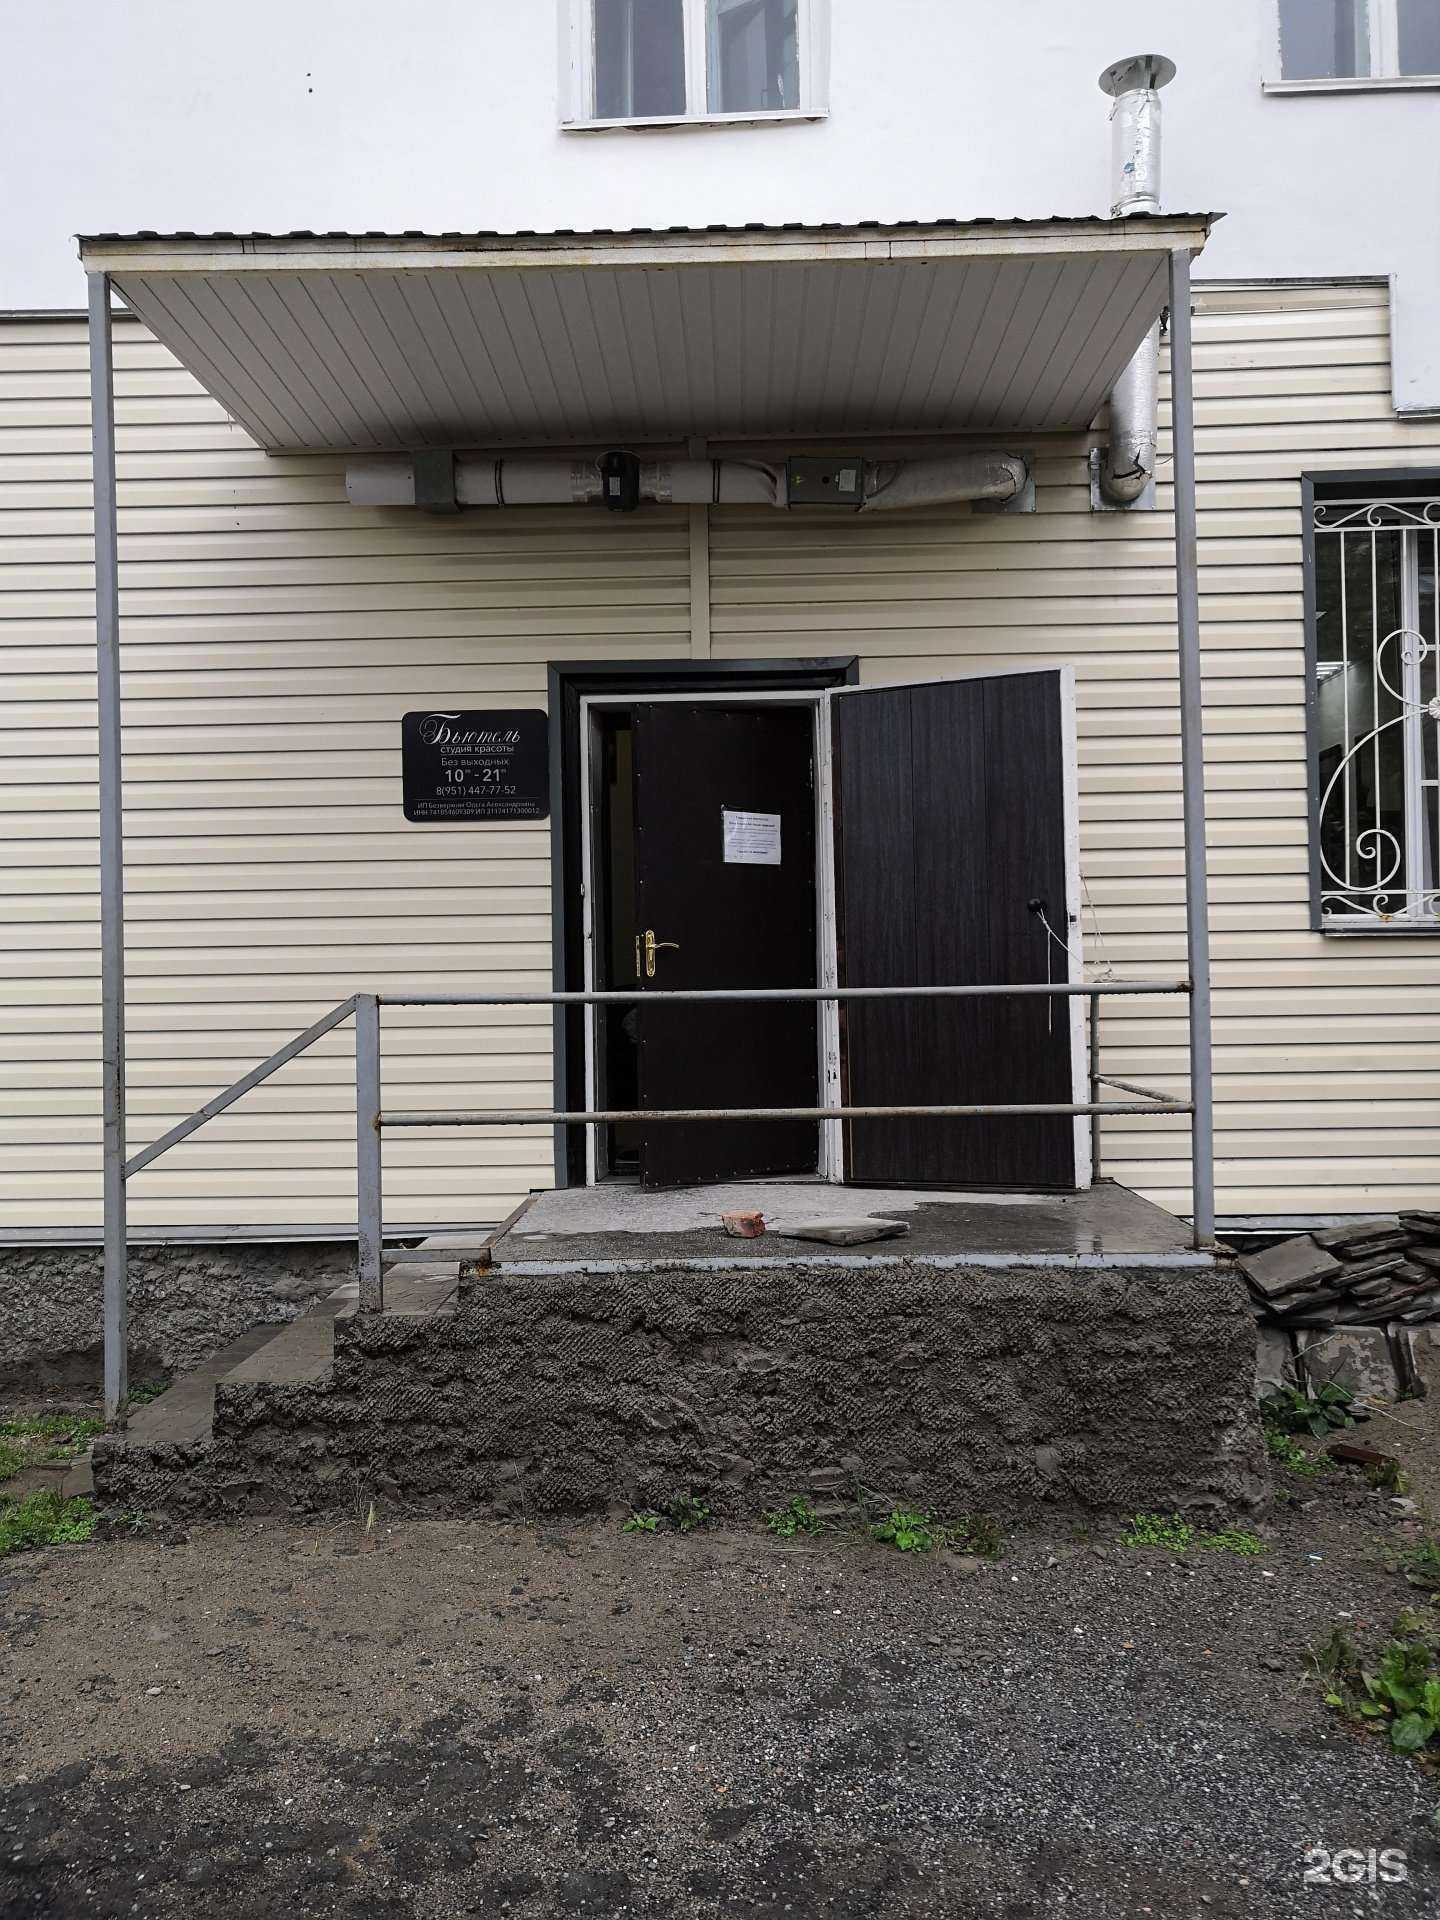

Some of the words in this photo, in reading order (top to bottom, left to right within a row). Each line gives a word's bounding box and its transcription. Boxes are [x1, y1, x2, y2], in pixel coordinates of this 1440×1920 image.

[440, 745, 472, 754] студия
[474, 745, 514, 754] красоты
[441, 757, 458, 766] Без
[460, 759, 510, 767] выходных
